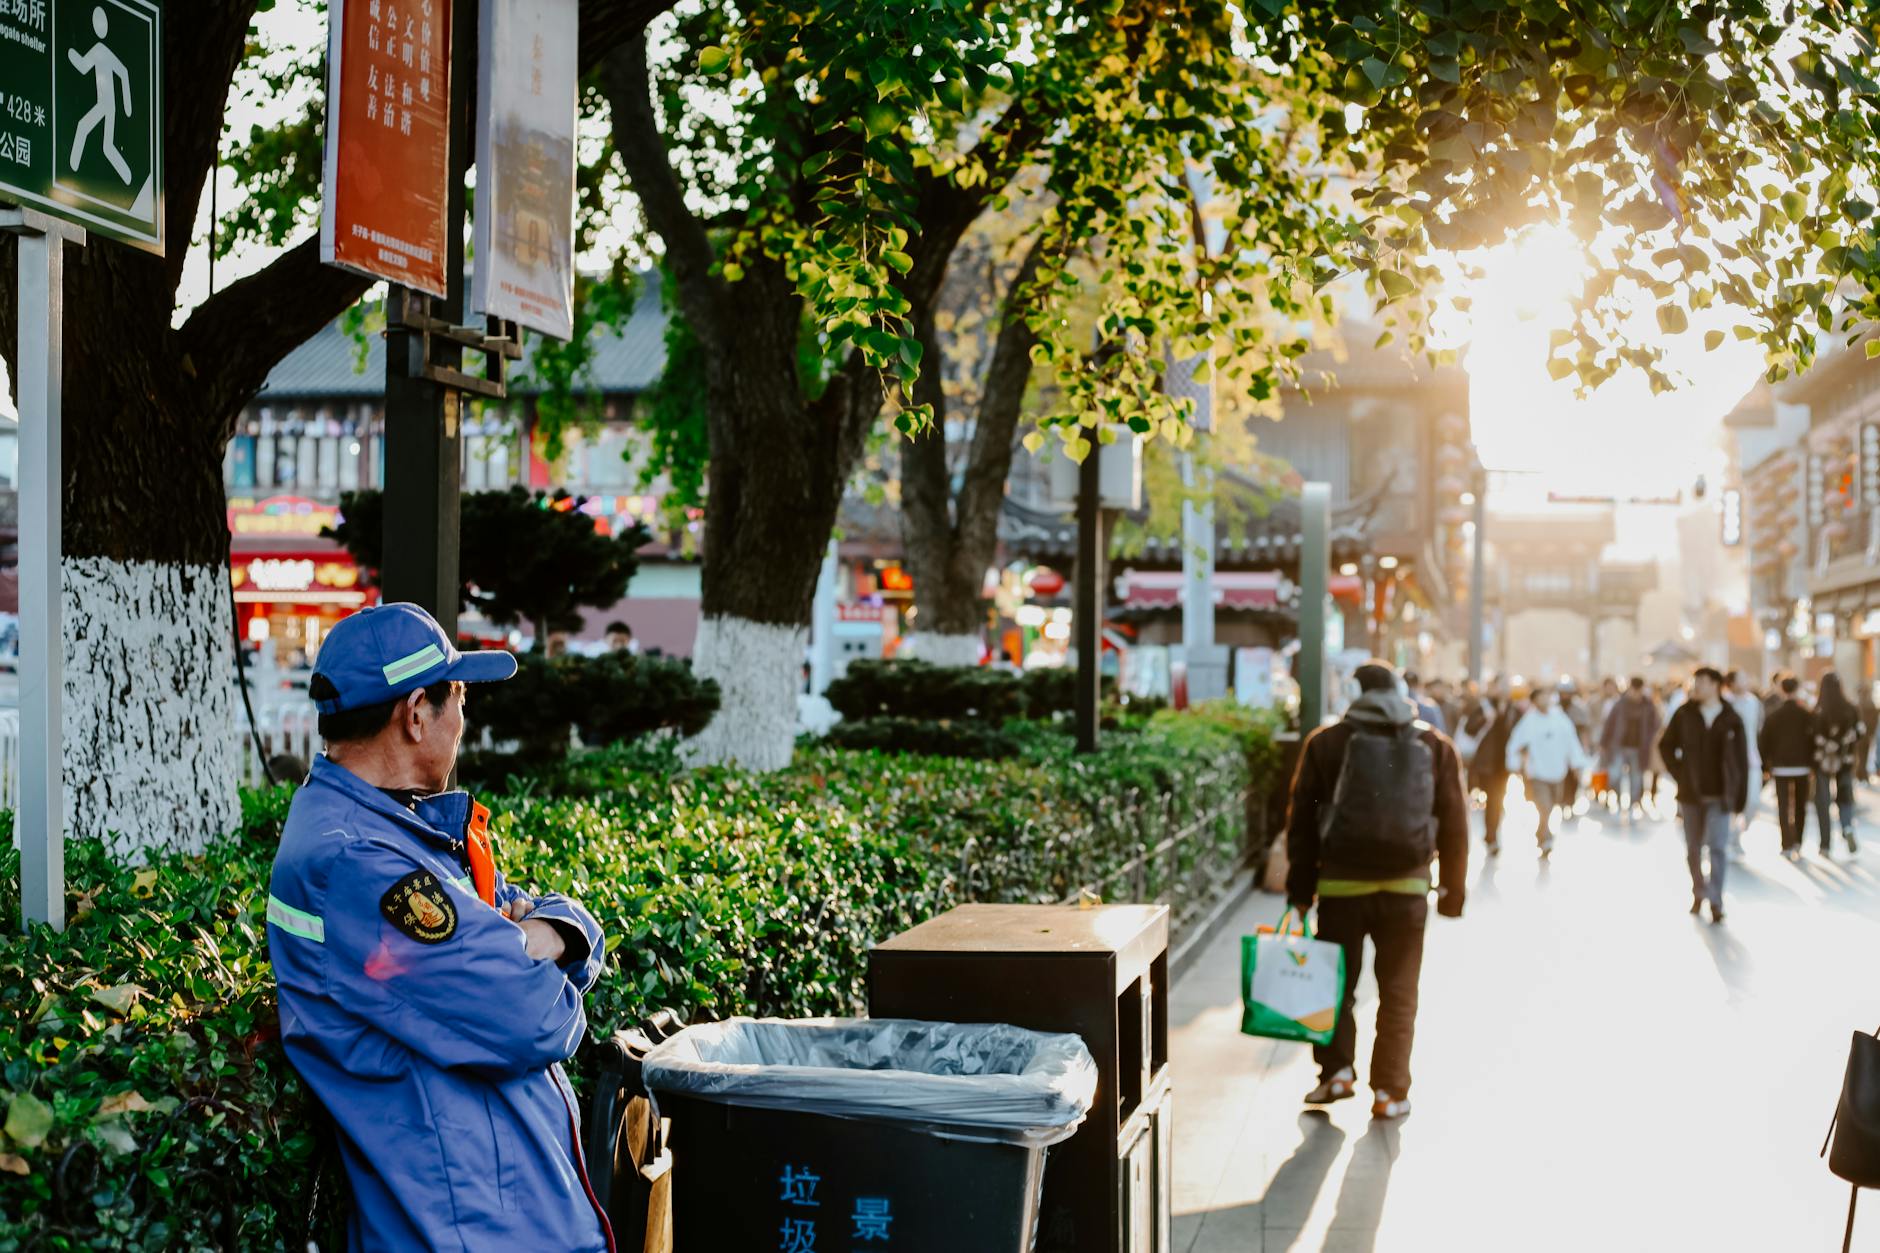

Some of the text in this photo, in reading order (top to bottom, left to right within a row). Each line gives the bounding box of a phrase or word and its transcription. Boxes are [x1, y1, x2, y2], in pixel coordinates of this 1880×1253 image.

[0, 0, 46, 32] 场所
[21, 32, 46, 54] shelter
[0, 131, 31, 168] 公园
